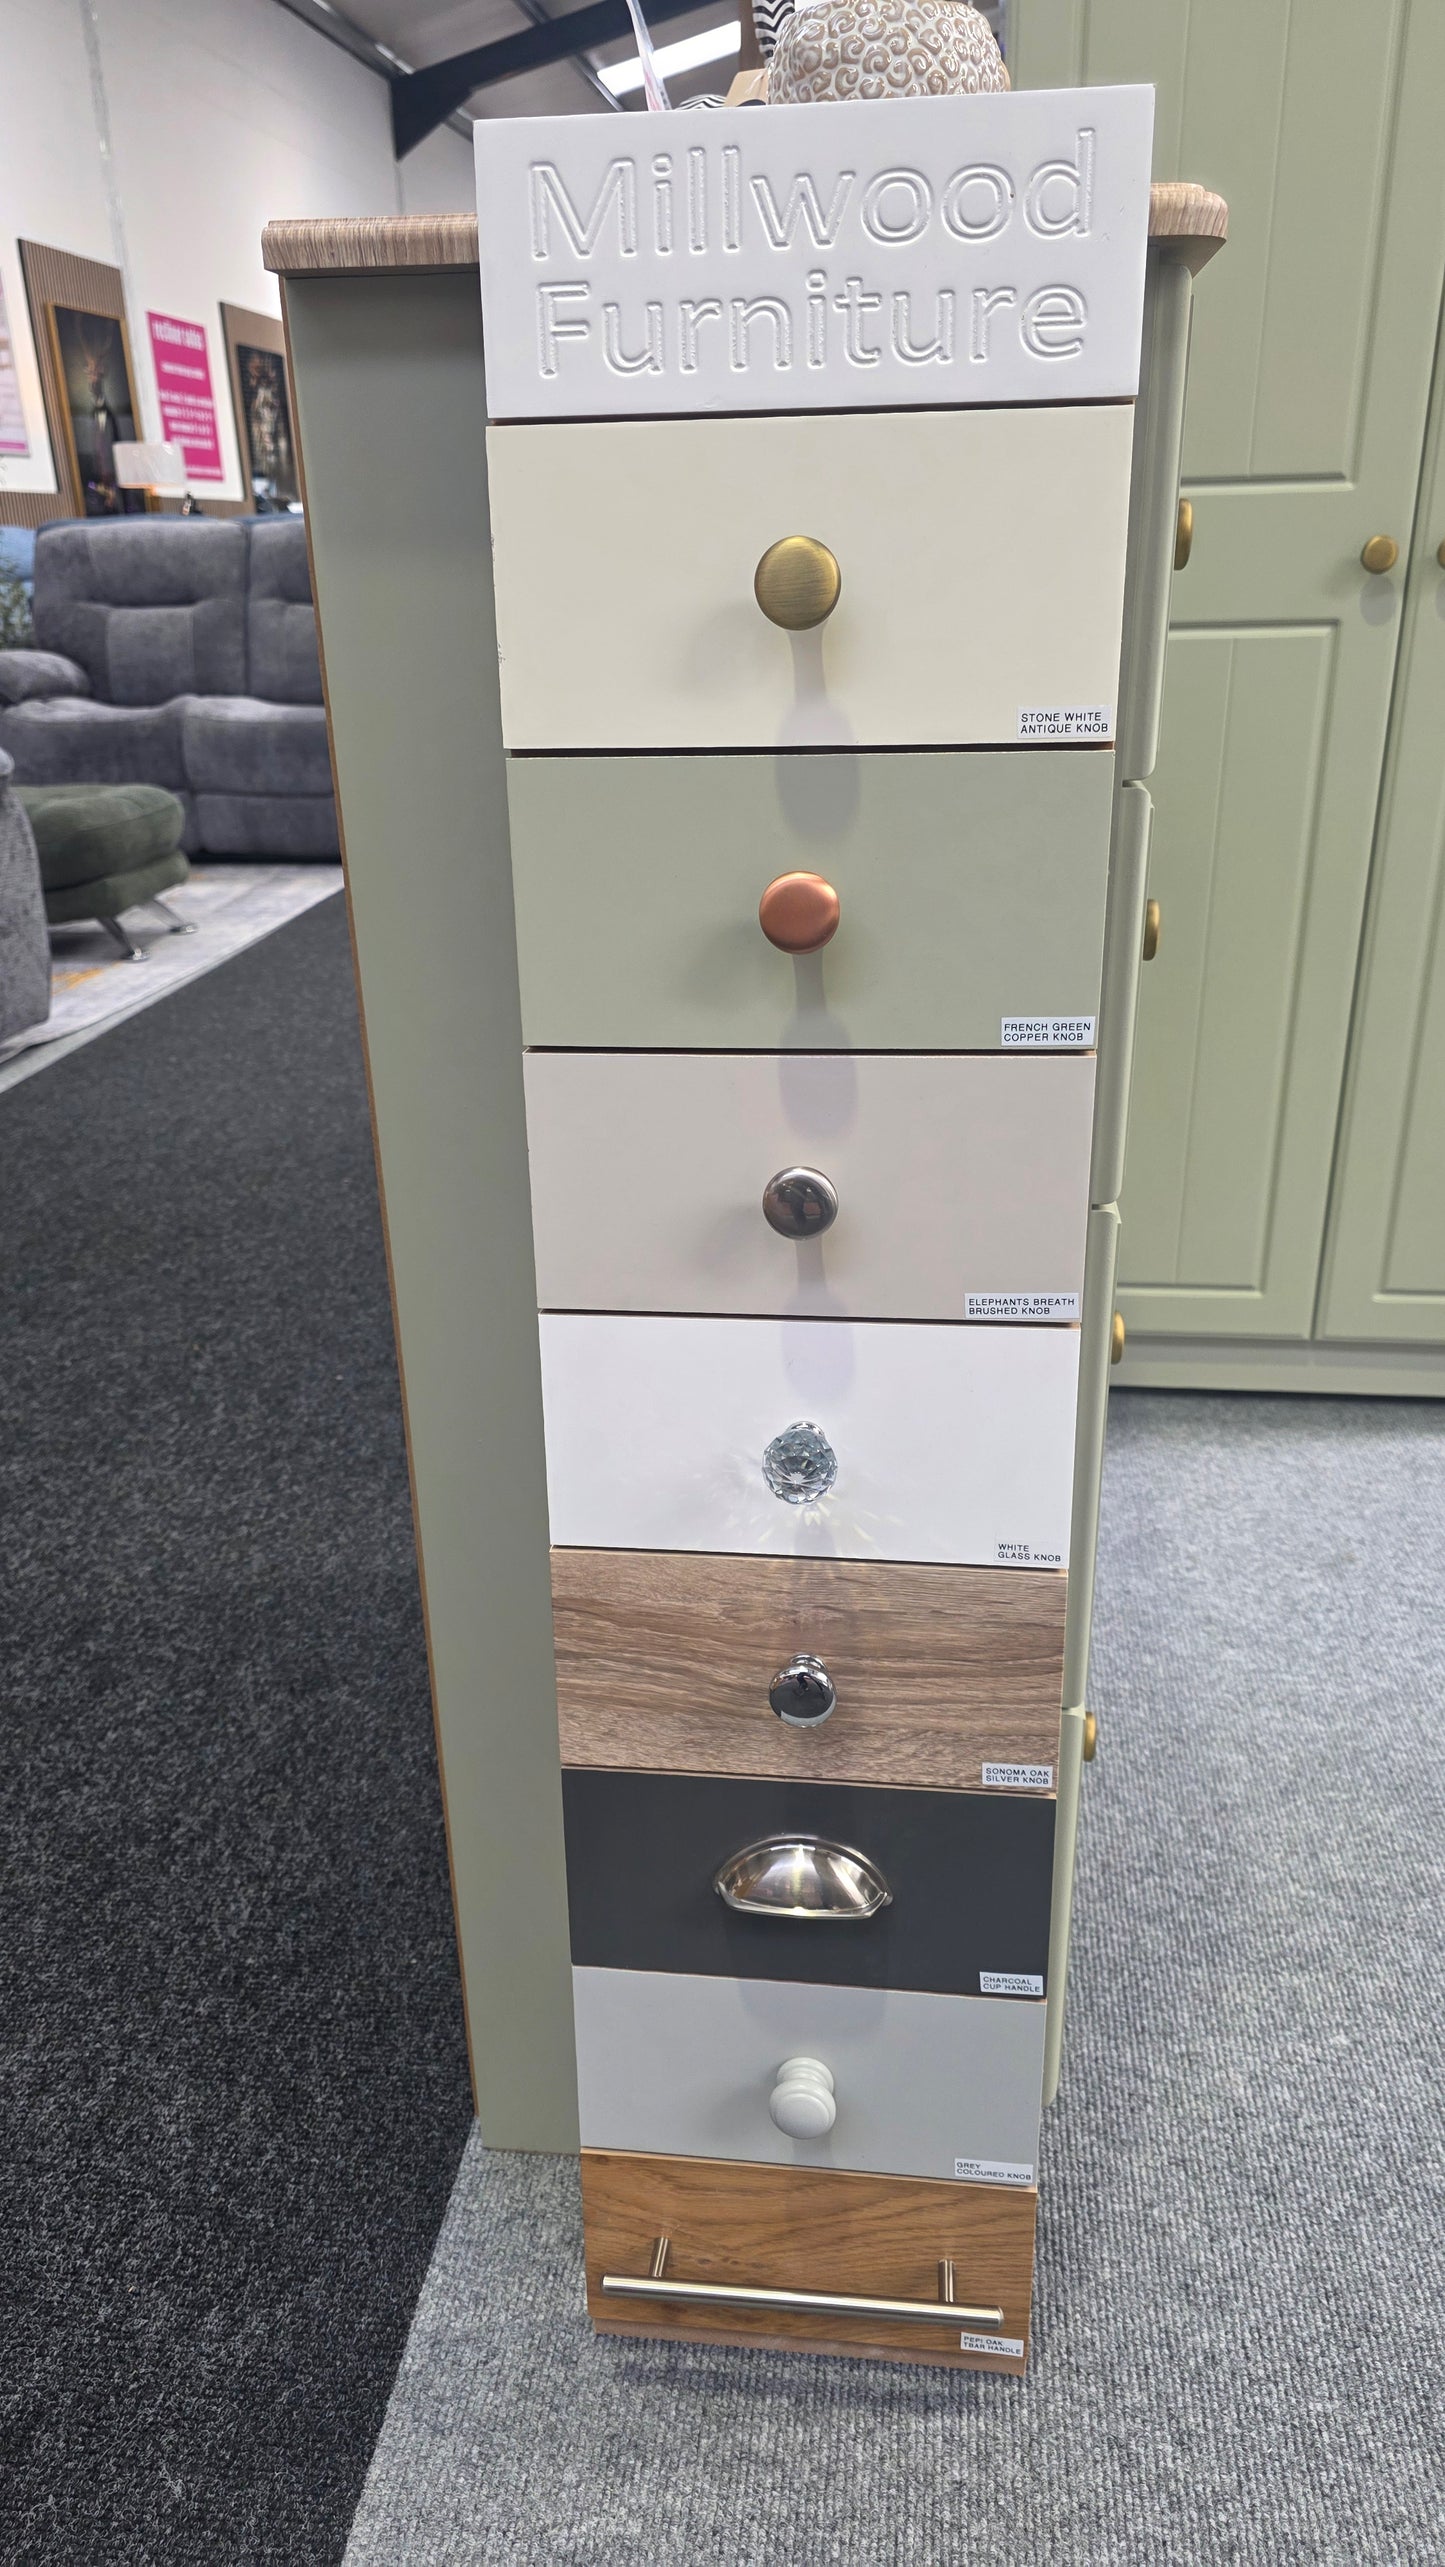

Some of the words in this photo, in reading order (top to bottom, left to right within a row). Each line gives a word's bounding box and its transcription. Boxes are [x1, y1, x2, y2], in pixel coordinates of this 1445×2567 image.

[527, 127, 1096, 260] Millwood
[534, 268, 1089, 379] Furniture
[1021, 712, 1060, 722] STONE
[1064, 712, 1102, 722] WHITE
[1020, 724, 1072, 734] ANTIQUE
[1076, 723, 1108, 732] KNOB
[1004, 1023, 1048, 1032] FRENCH
[1052, 1022, 1090, 1031] GREEN
[1004, 1033, 1048, 1042] COPPER
[1053, 1032, 1083, 1041] KNOB
[968, 1298, 1030, 1306] ELEPHANTS
[998, 1544, 1030, 1552] WHITE
[998, 1552, 1030, 1560] GLASS
[1034, 1554, 1061, 1562] KNOB
[986, 1768, 1026, 1776] SONOMA
[983, 1976, 1032, 1985] CHARCOAL
[956, 2168, 1004, 2178] COLOURED
[988, 2345, 1021, 2354] HANDLE
